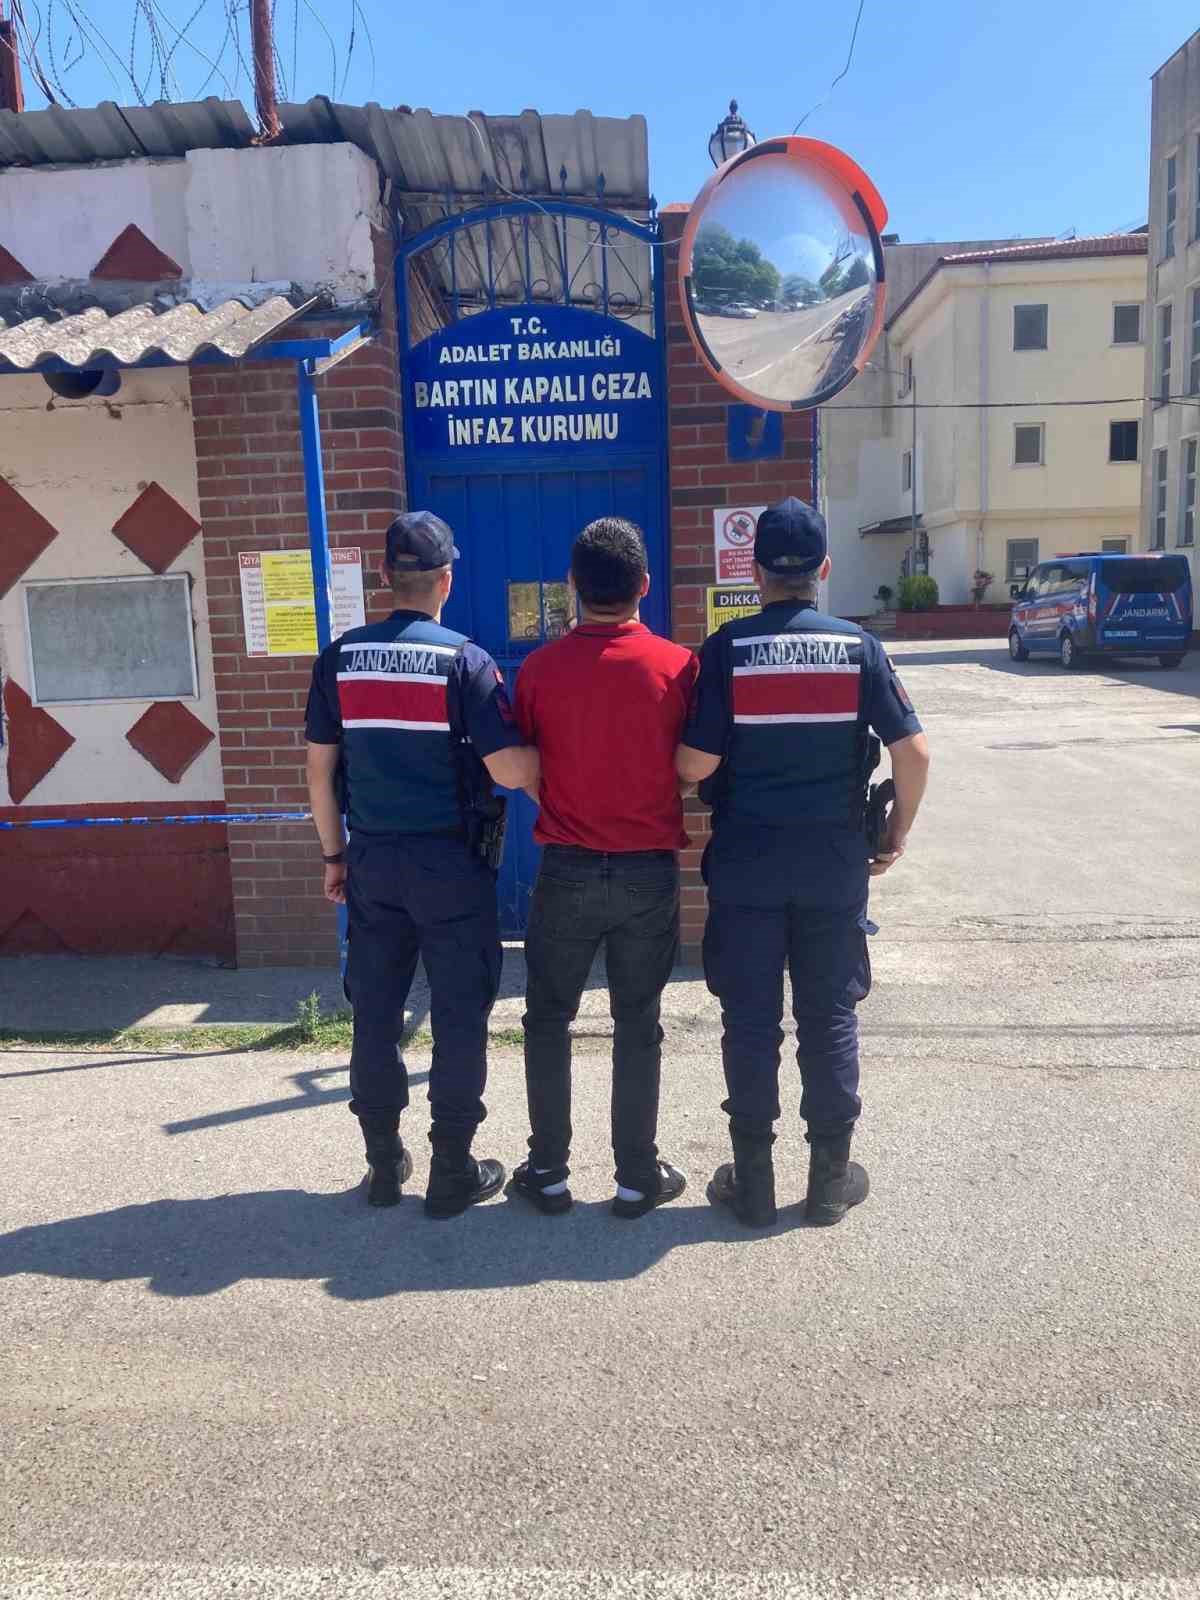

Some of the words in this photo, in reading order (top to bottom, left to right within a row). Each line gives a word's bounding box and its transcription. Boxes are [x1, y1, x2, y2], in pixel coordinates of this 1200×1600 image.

[510, 317, 547, 335] T.C.
[439, 344, 512, 363] ADALET
[518, 335, 621, 360] BAKANLIĞI
[414, 379, 497, 407] BARTIN
[505, 375, 585, 404] KAPALI
[591, 372, 652, 400] CEZA
[448, 414, 515, 445] İNFAZ
[521, 413, 619, 443] KURUMU
[719, 592, 762, 606] DİKKA
[1121, 607, 1169, 617] JANDARMA
[346, 649, 438, 674] JANDARMA
[744, 641, 850, 666] JANDARMA
